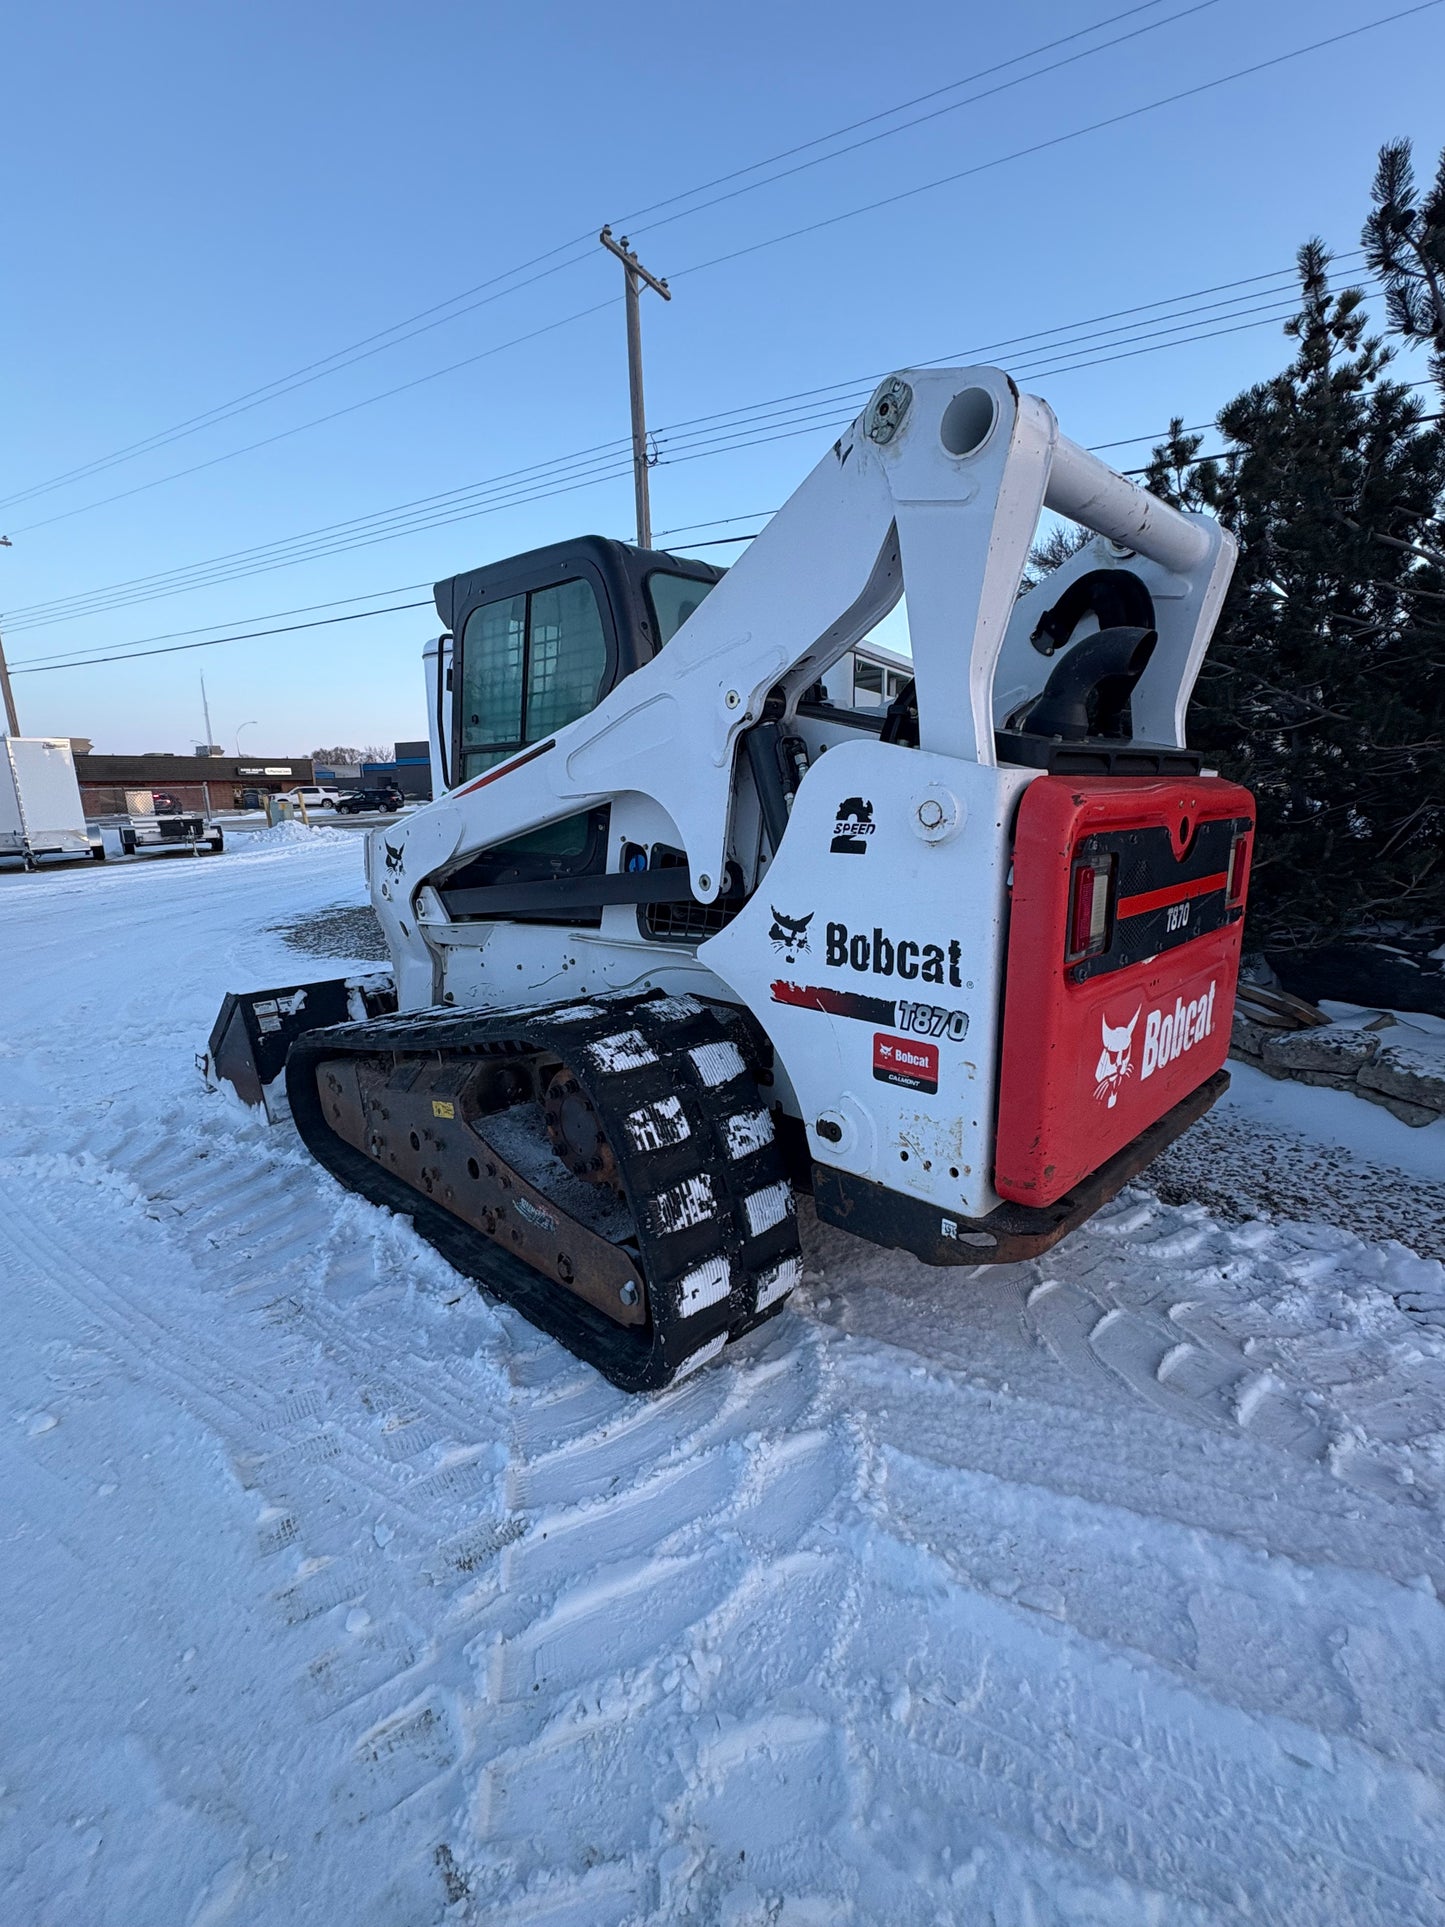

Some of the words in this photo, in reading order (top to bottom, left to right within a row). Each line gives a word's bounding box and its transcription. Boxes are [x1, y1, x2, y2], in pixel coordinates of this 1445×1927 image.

[830, 797, 873, 854] 2
[833, 823, 876, 835] SPEED
[1166, 902, 1190, 932] T870
[826, 922, 962, 987] Bobcat
[899, 1000, 969, 1042] T870
[1140, 980, 1216, 1081] Bobcat
[895, 1049, 930, 1068] Bobcat
[888, 1074, 921, 1087] CALMONT
